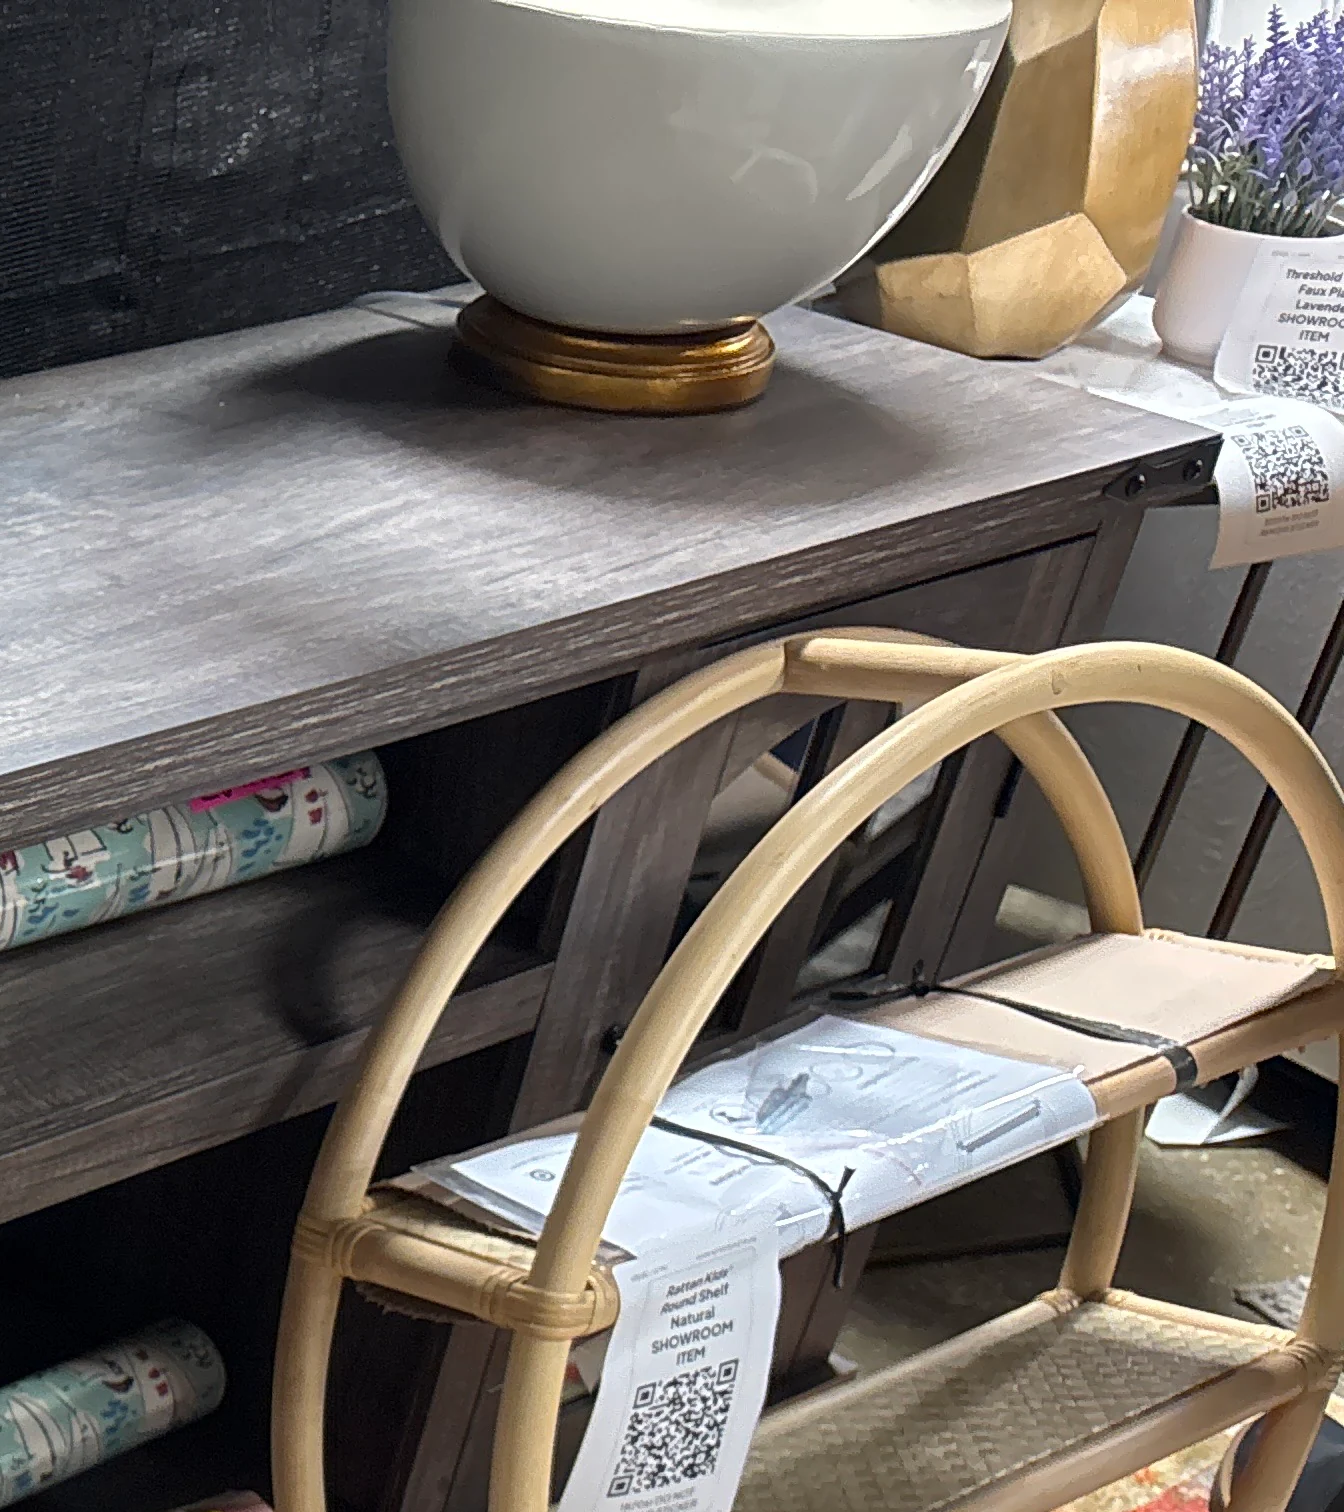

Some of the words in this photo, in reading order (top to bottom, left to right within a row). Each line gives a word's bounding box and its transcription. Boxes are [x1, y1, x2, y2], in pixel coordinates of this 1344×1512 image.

[1286, 269, 1342, 282] Threshold
[1298, 284, 1326, 296] Faux
[1298, 330, 1330, 342] ITEM
[699, 1282, 729, 1300] Shelf
[670, 1306, 715, 1329] Natural
[651, 1320, 733, 1354] SHOWROOM
[676, 1347, 705, 1366] ITEM
